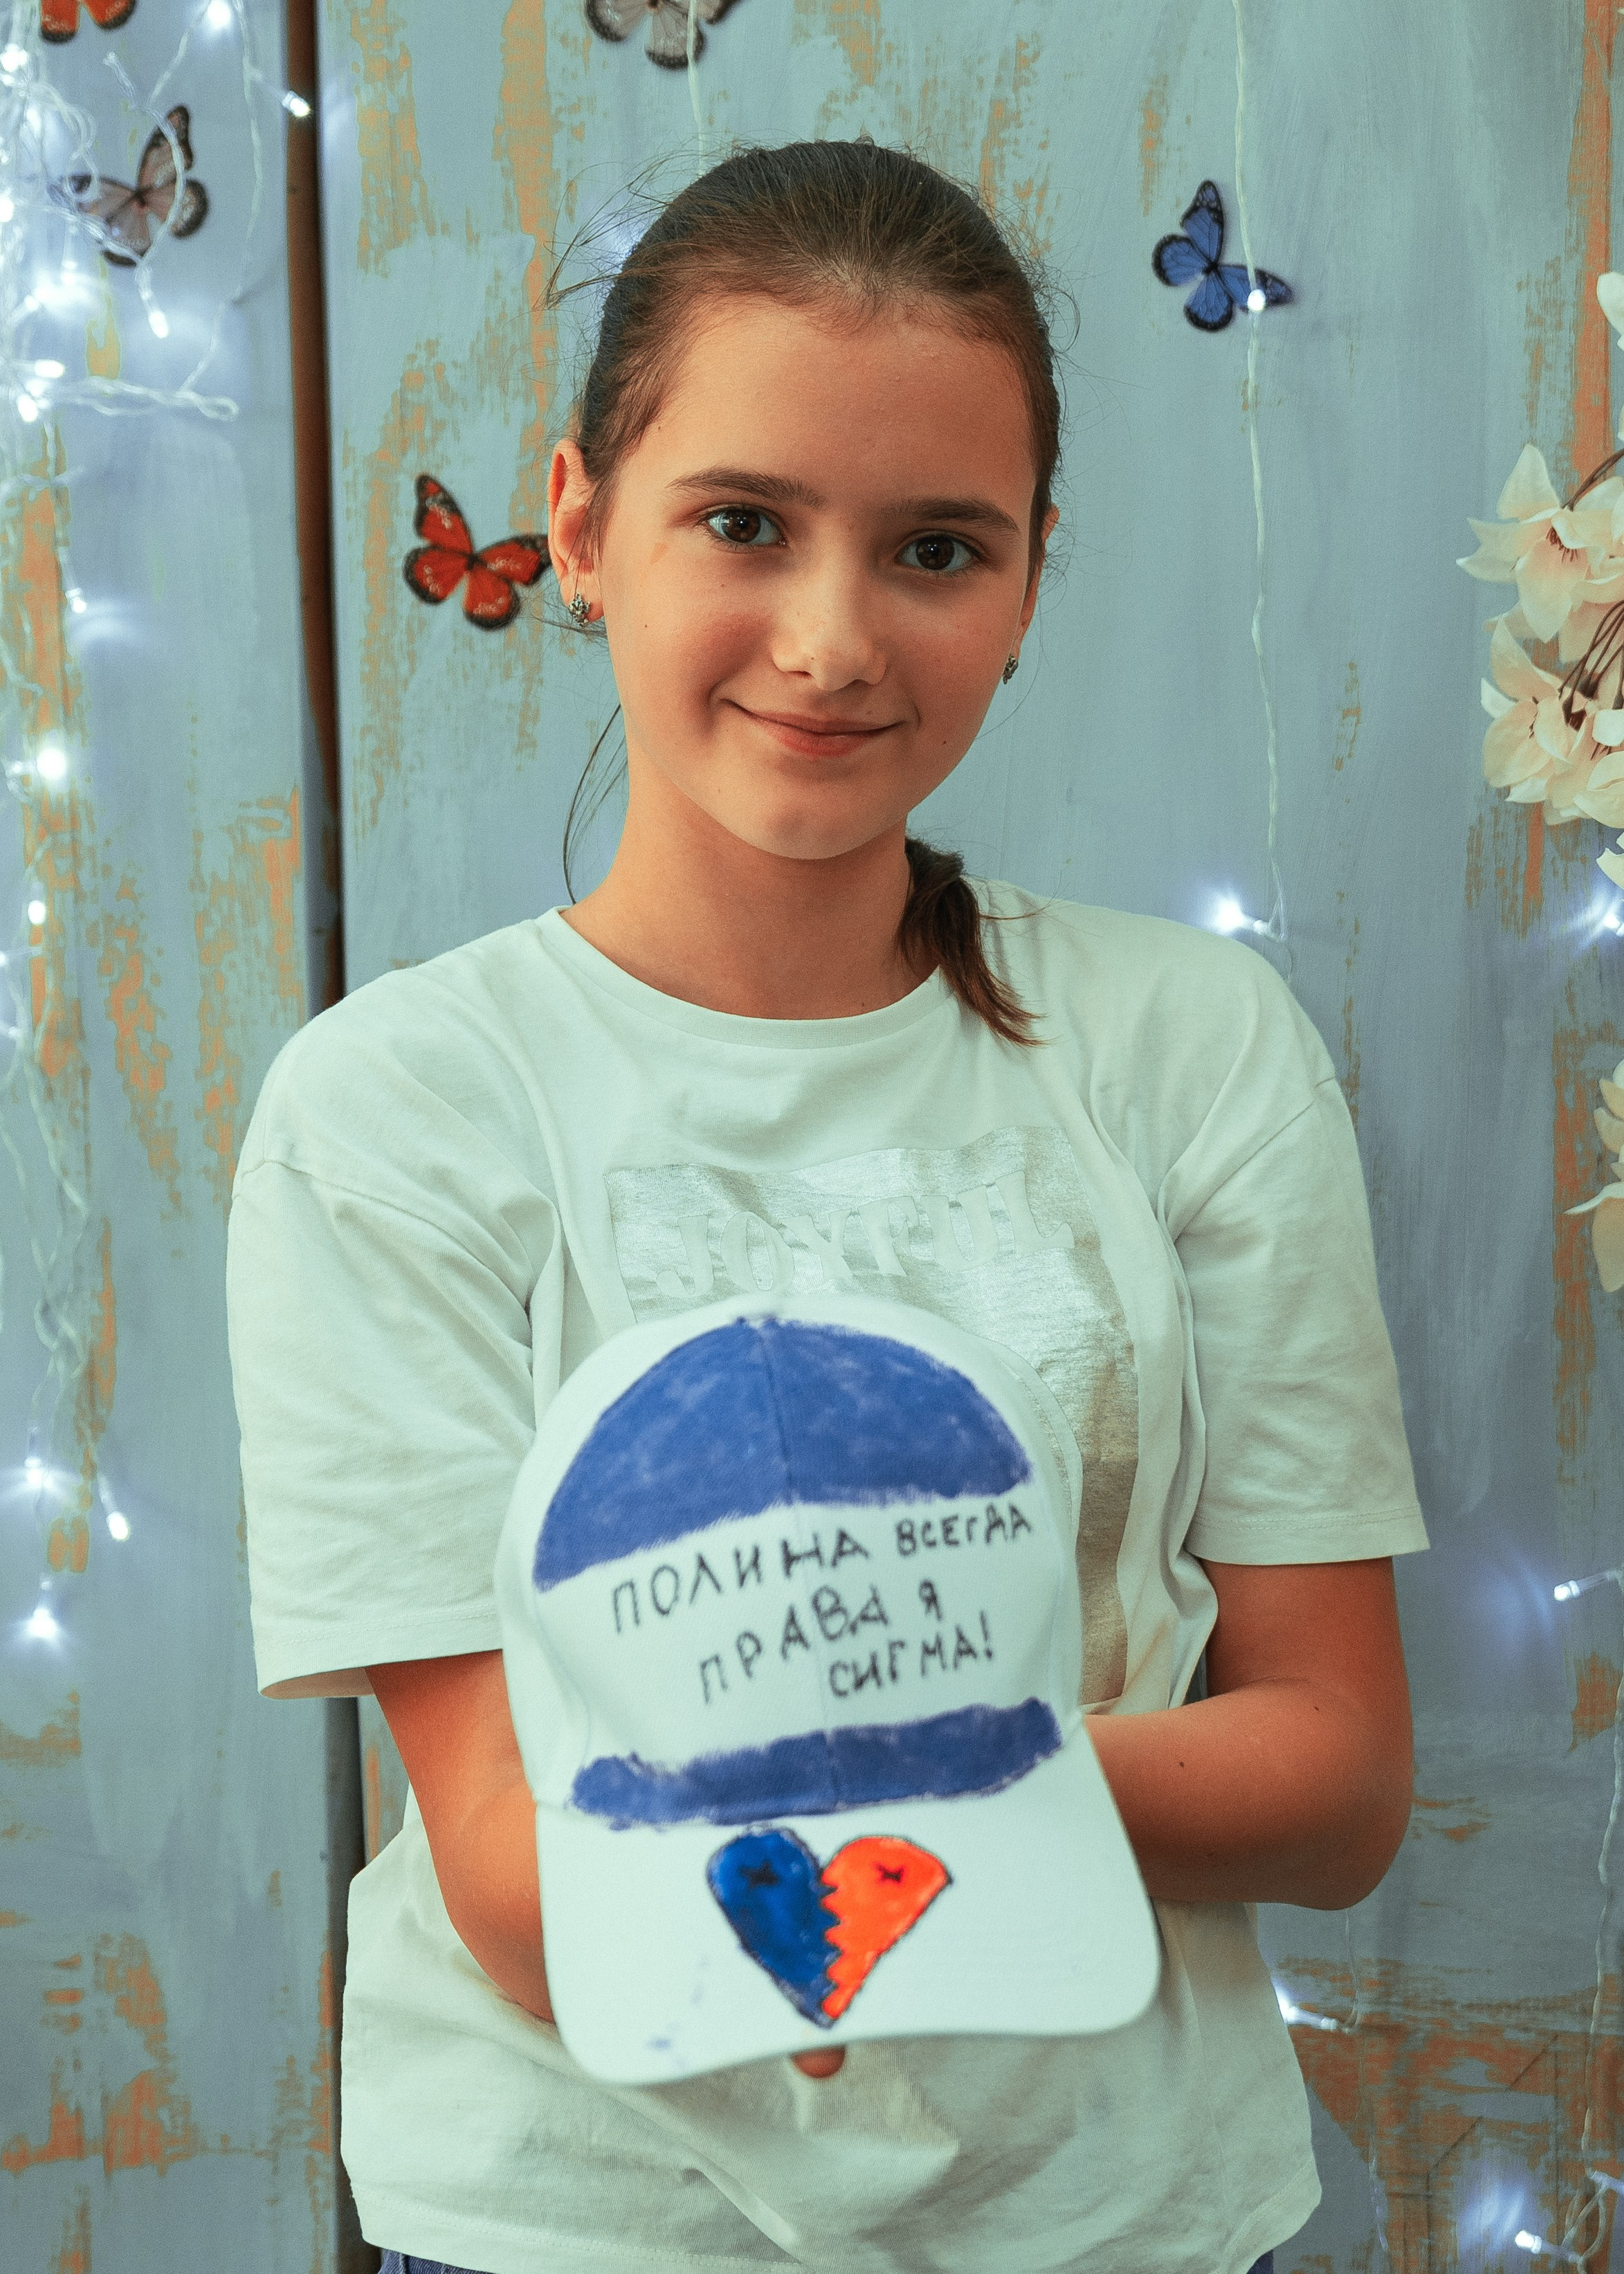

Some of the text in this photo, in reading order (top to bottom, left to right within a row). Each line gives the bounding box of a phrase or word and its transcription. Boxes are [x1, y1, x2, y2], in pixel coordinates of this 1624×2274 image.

[655, 1170, 1075, 1296] JOYFUL
[612, 1528, 870, 1633] ПОЛИНА
[699, 1579, 942, 1704] ПРАВА Я
[829, 1610, 994, 1698] СИГМА!
